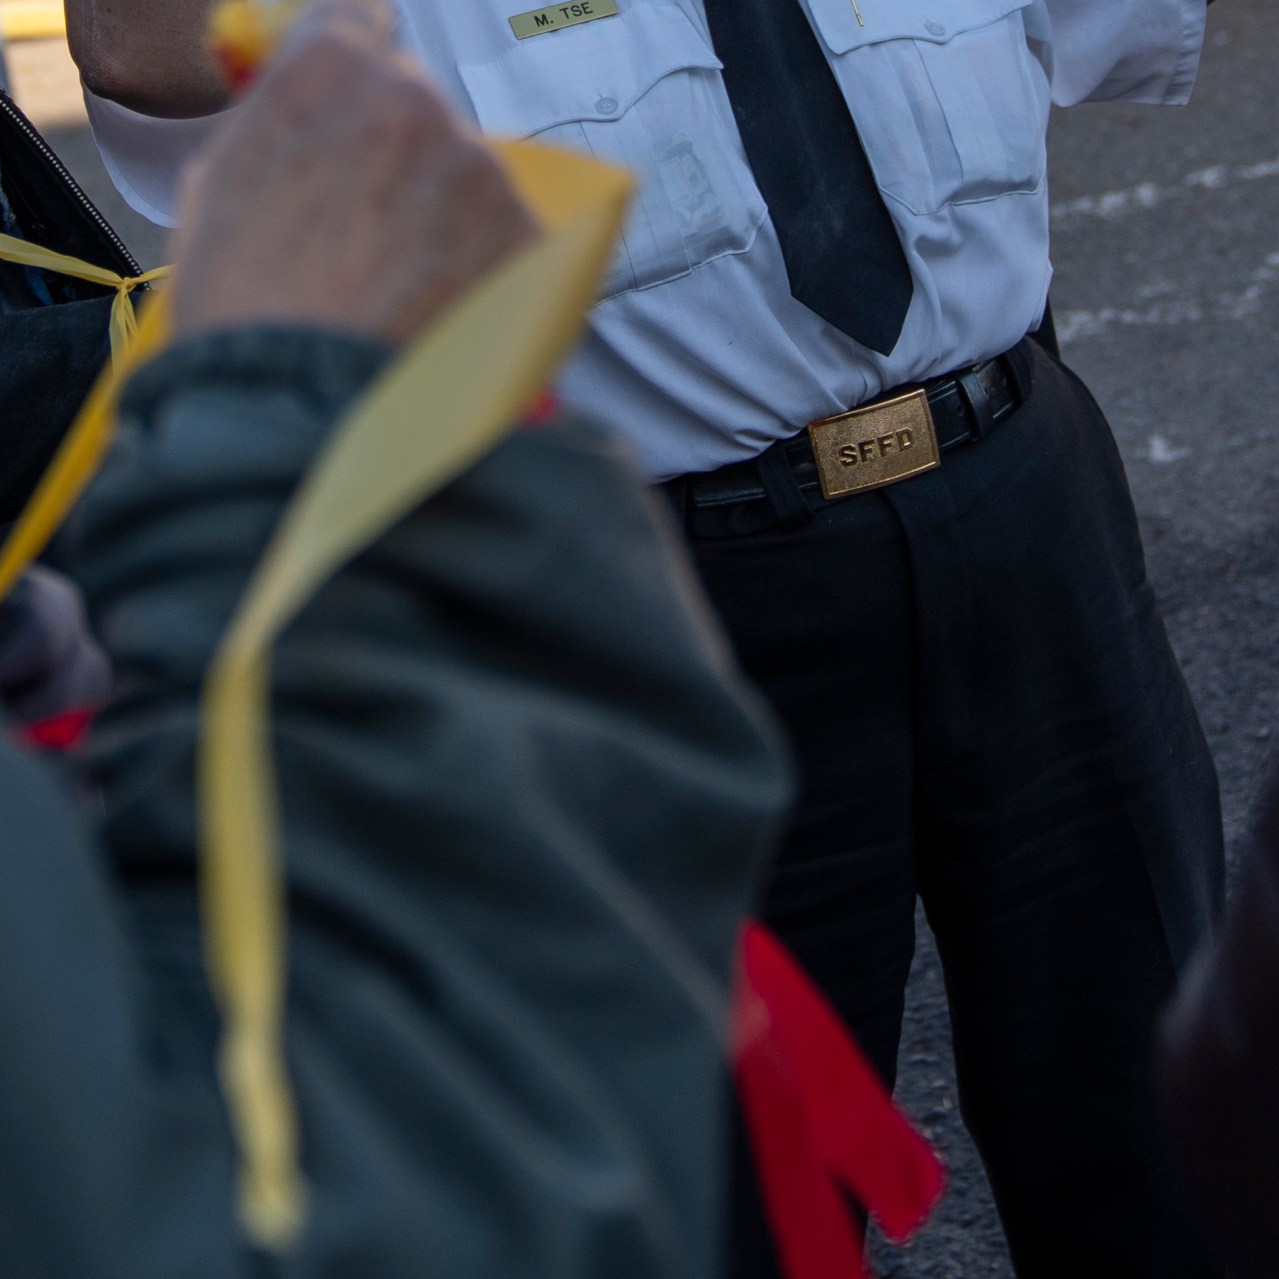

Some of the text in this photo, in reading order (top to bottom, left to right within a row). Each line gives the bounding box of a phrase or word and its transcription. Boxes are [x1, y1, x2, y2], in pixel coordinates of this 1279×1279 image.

[534, 1, 594, 27] M. TSE
[838, 426, 913, 467] SFFD
